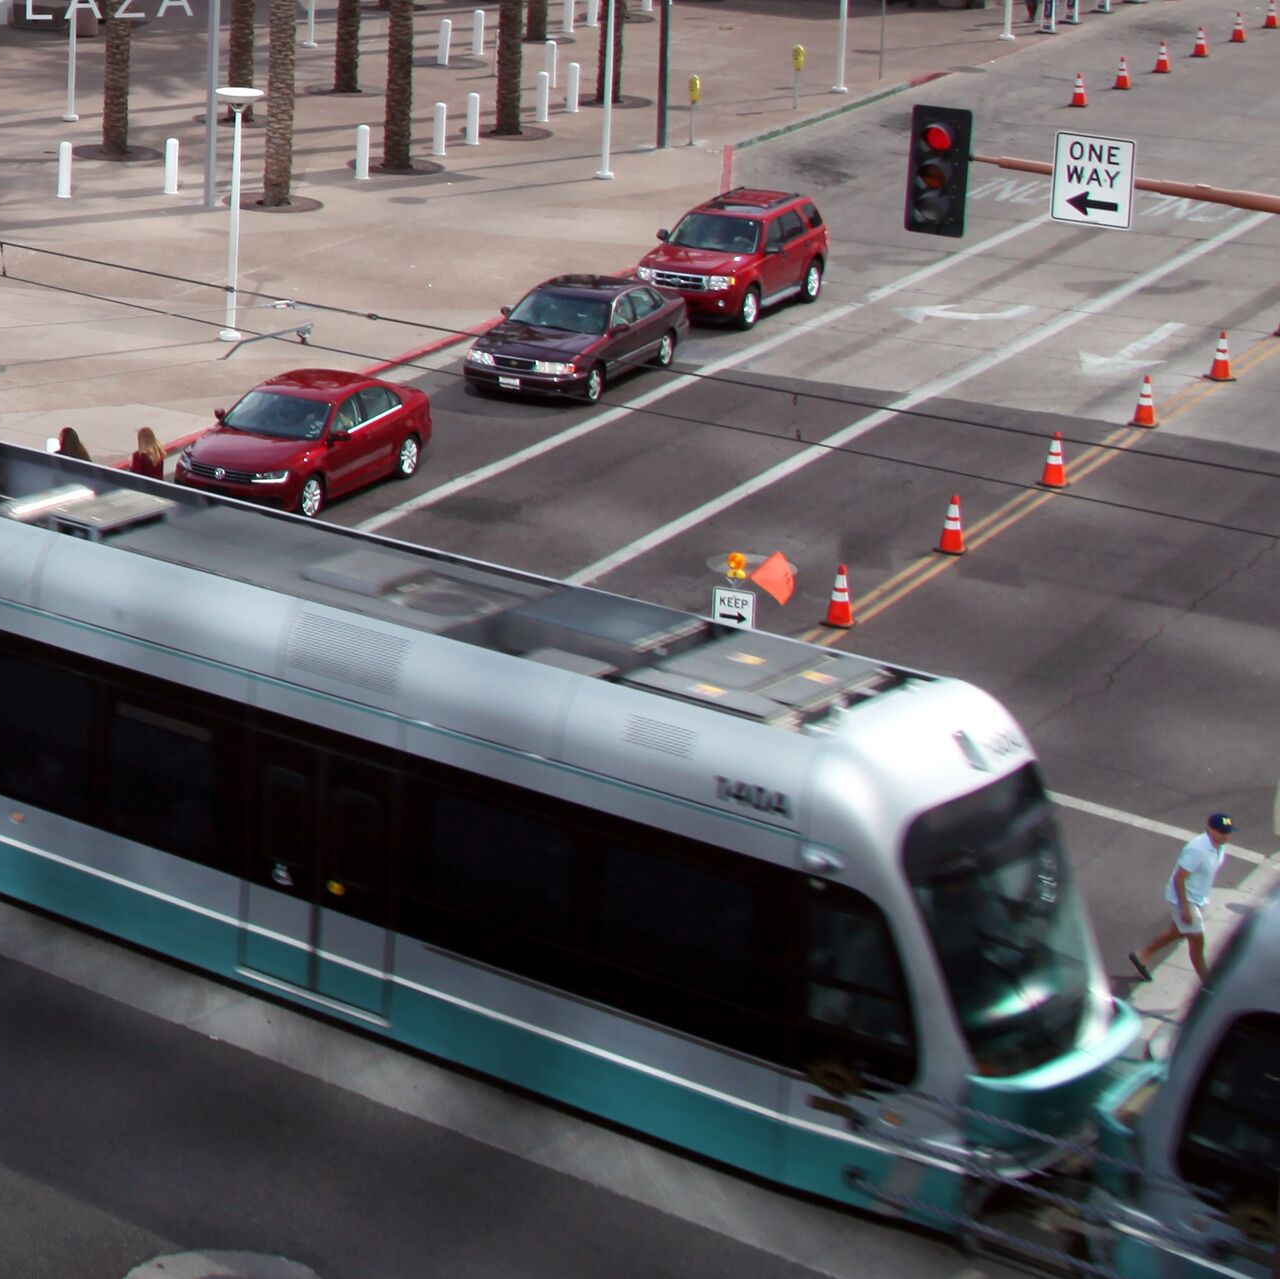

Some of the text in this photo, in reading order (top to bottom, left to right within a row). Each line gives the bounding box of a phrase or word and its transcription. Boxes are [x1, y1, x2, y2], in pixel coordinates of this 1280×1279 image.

[1069, 141, 1121, 166] ONE
[1066, 165, 1121, 189] WAY
[719, 596, 749, 610] KEEP
